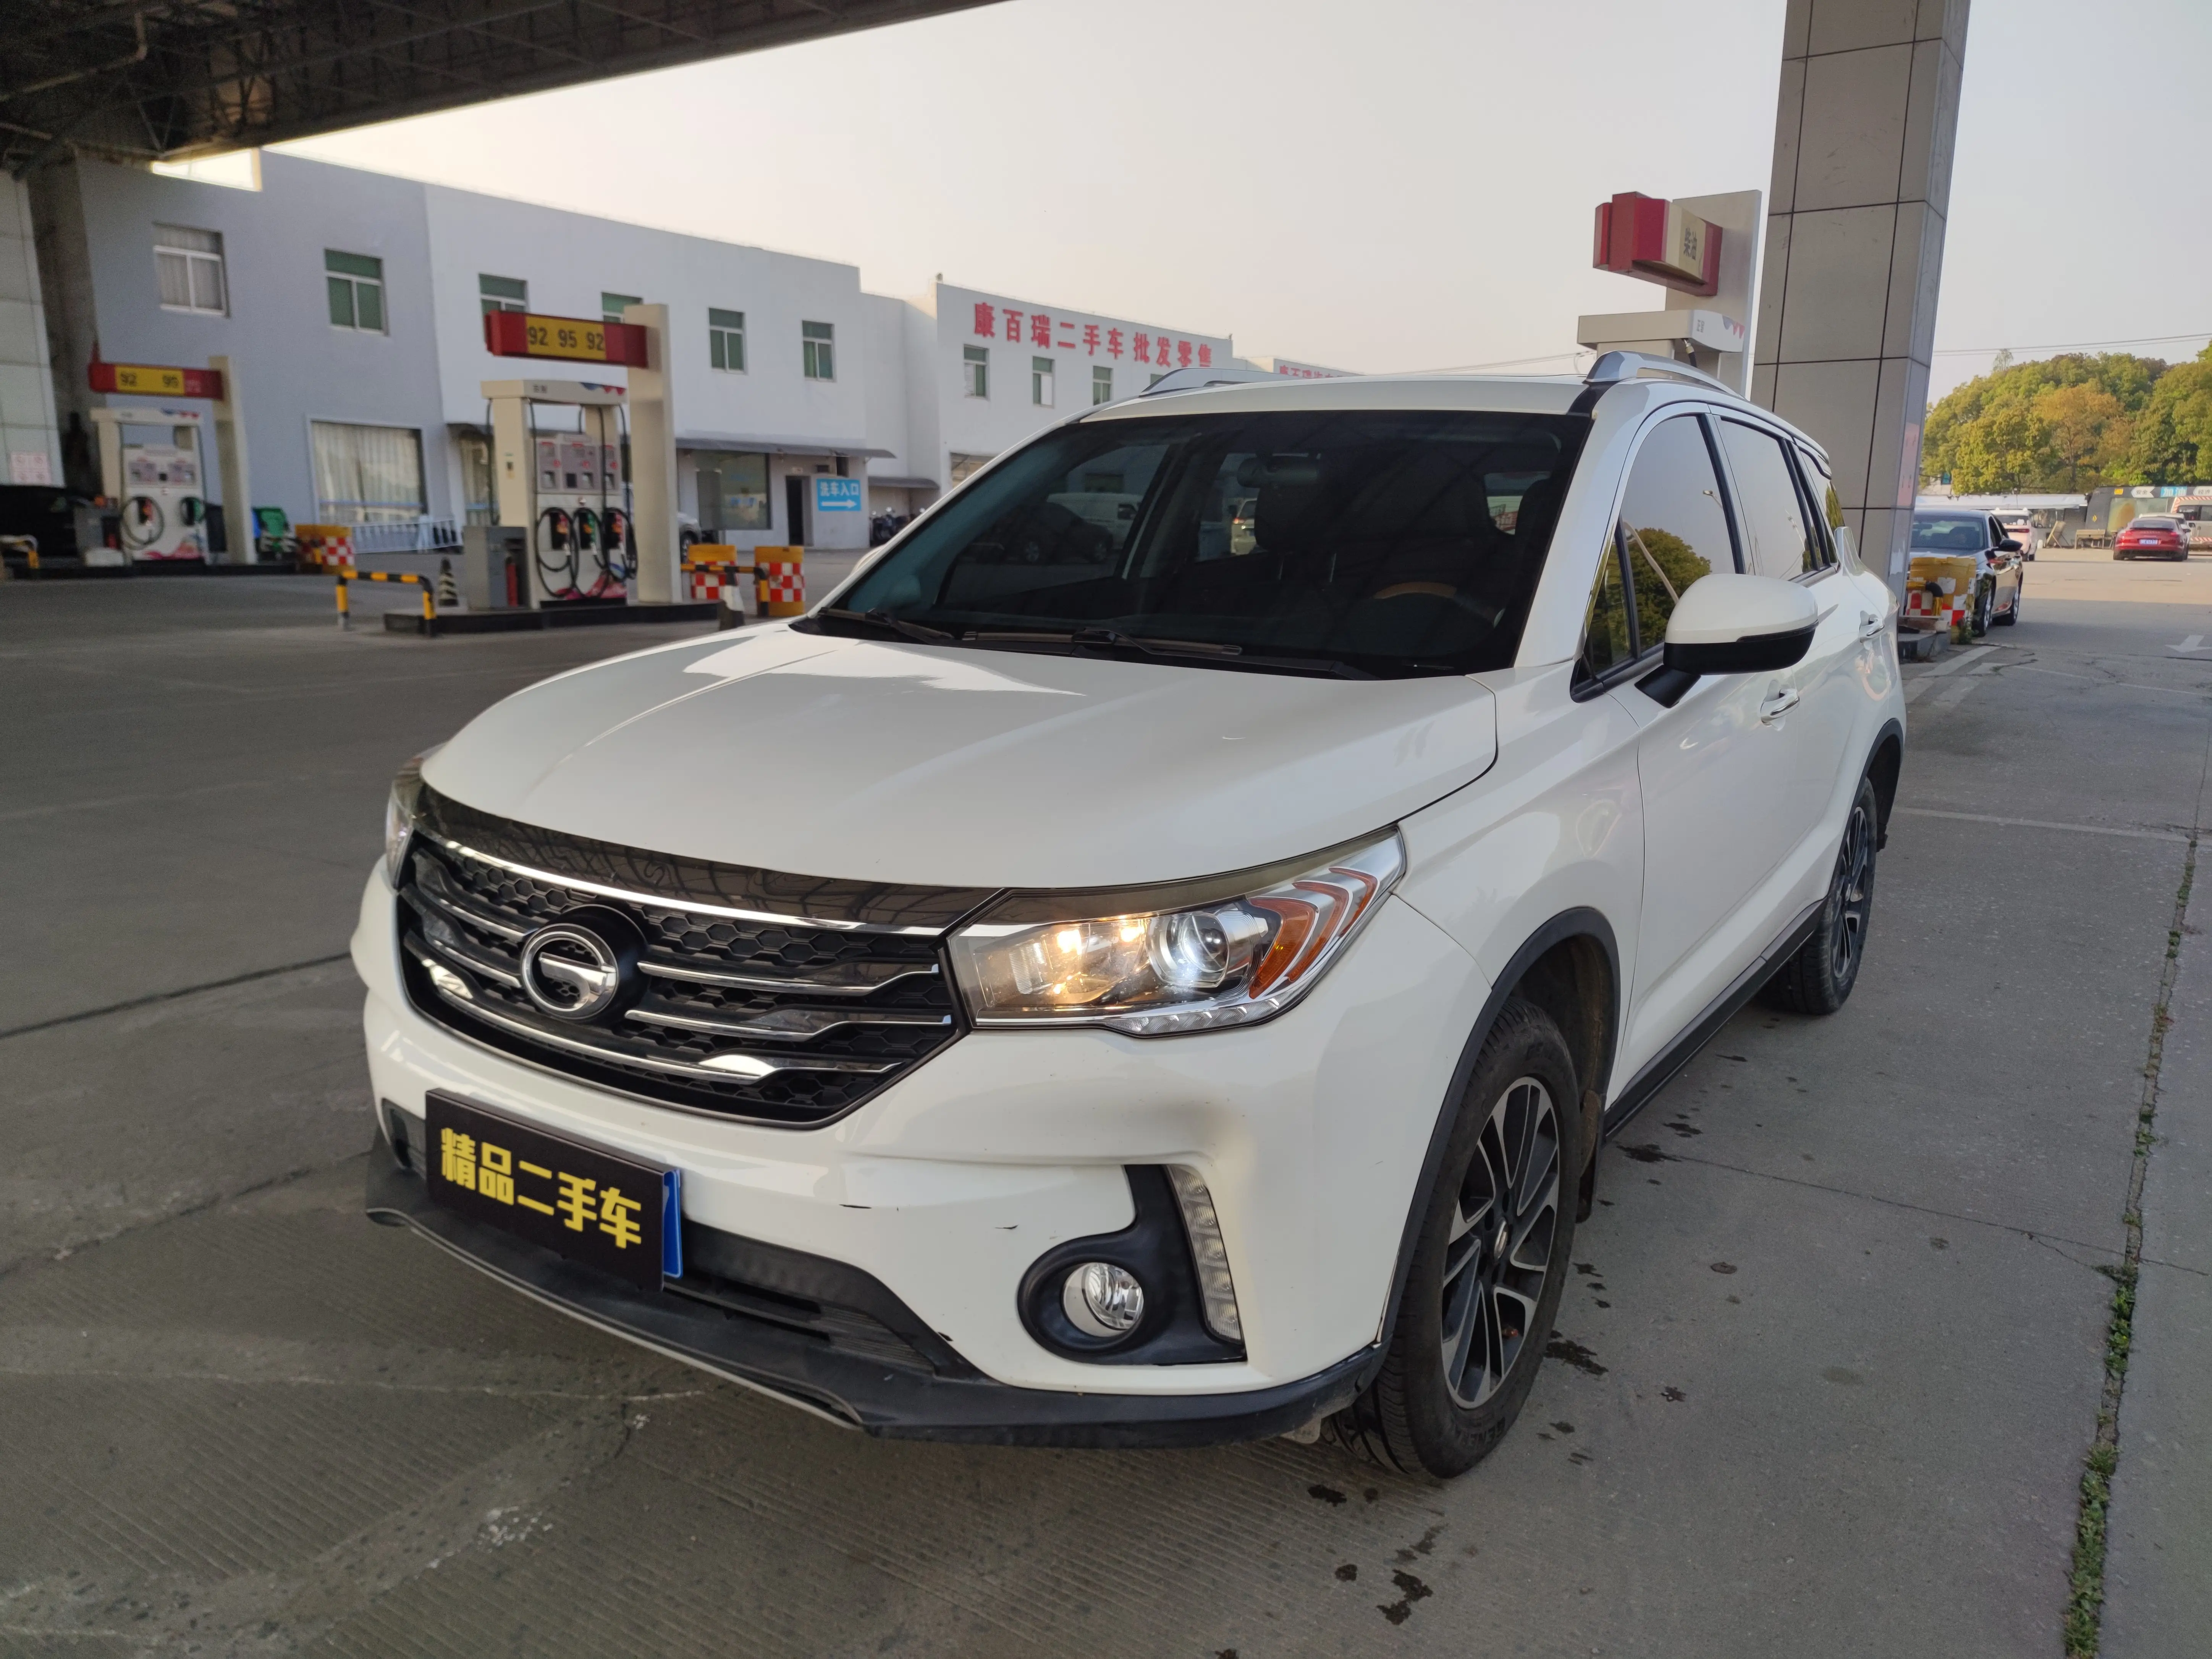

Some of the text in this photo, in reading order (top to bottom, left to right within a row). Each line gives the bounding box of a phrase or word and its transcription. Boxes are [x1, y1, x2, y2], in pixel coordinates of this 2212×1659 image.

[1683, 227, 1698, 260] 柴油
[528, 327, 605, 351] 92 95 92
[120, 372, 137, 386] 92
[820, 481, 859, 496] 洗车入口
[2163, 488, 2186, 497] 加油
[441, 1127, 642, 1249] 精品二手车
